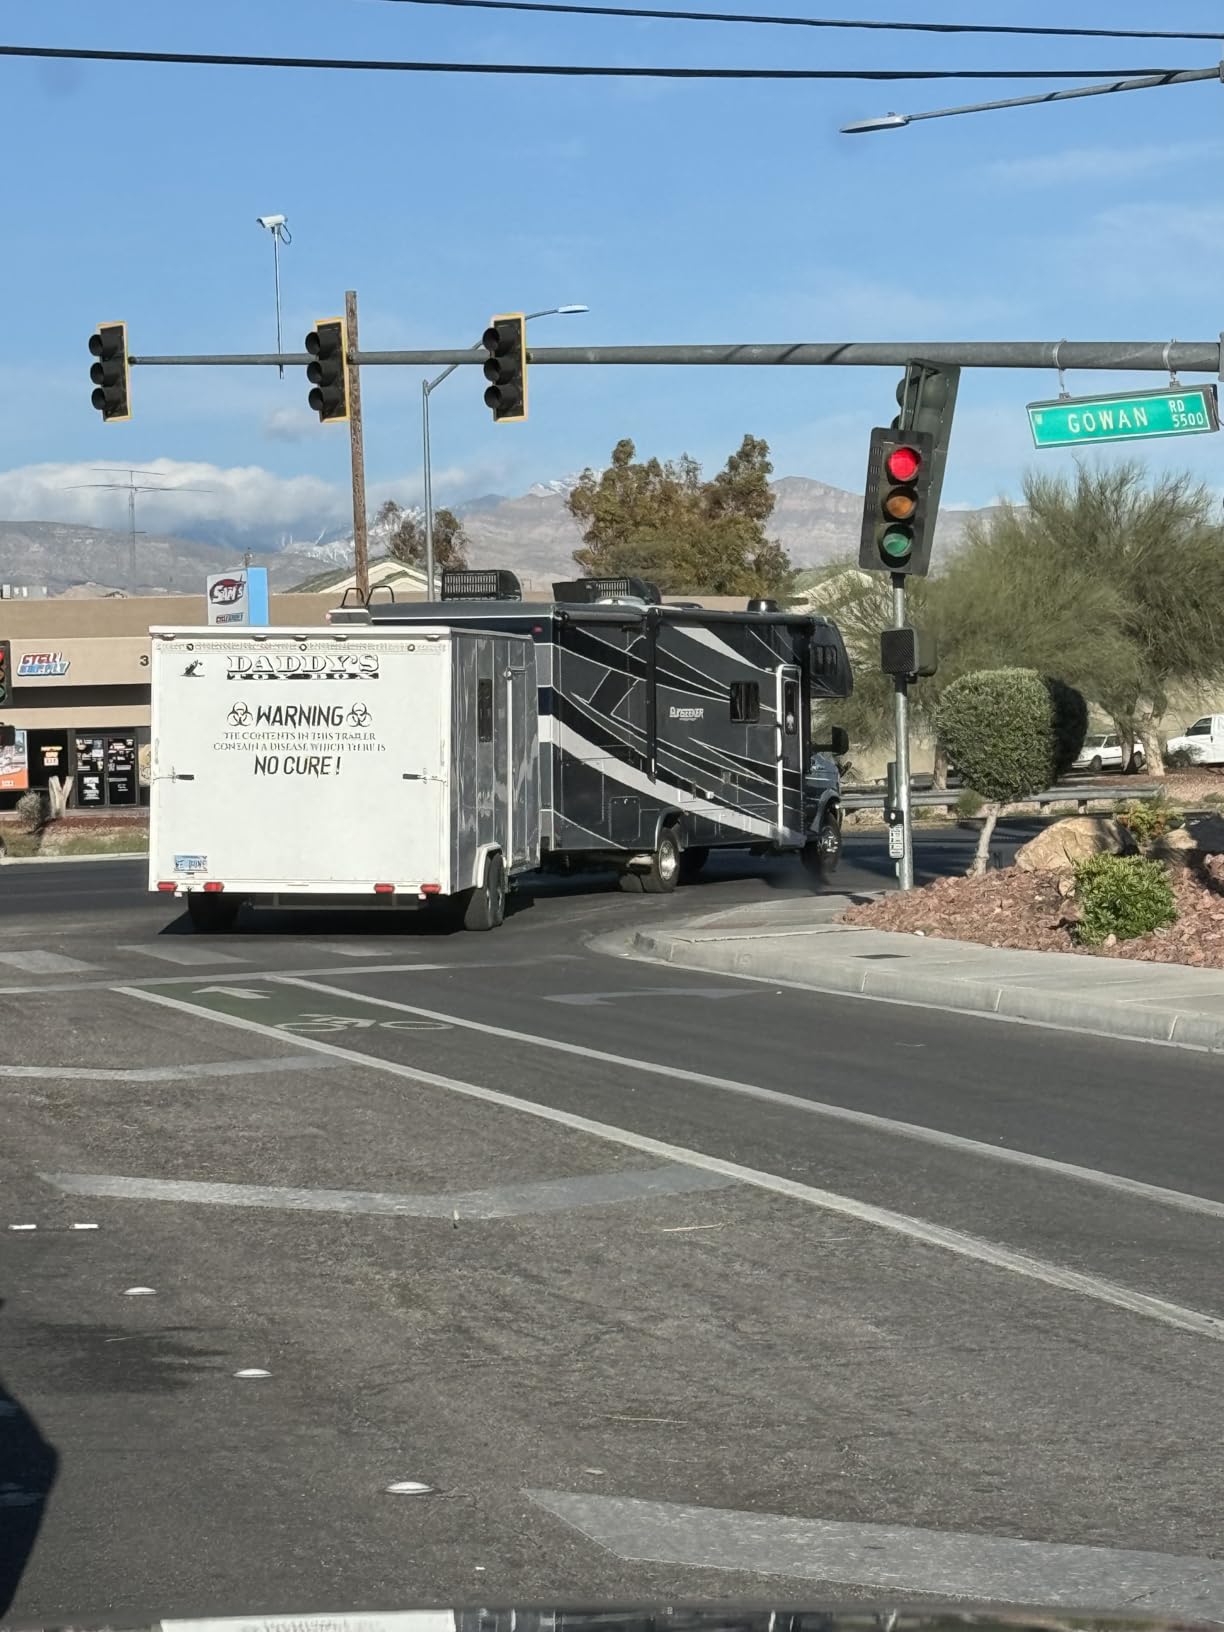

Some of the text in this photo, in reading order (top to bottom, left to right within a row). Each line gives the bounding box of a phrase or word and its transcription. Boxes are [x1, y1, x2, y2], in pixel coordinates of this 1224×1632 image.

[1067, 407, 1149, 434] GOWAN
[1168, 399, 1185, 412] RD
[1172, 412, 1204, 428] 5500
[227, 655, 380, 673] DADDY'S
[256, 704, 343, 729] WARNING
[225, 732, 376, 741] THE CONTENTS IN THIS TRAILER
[213, 743, 259, 752] CONTAIN
[260, 743, 268, 752] A
[270, 743, 309, 752] DISEASE
[310, 743, 345, 752] WHICH
[375, 743, 386, 752] IS
[254, 754, 279, 776] NO
